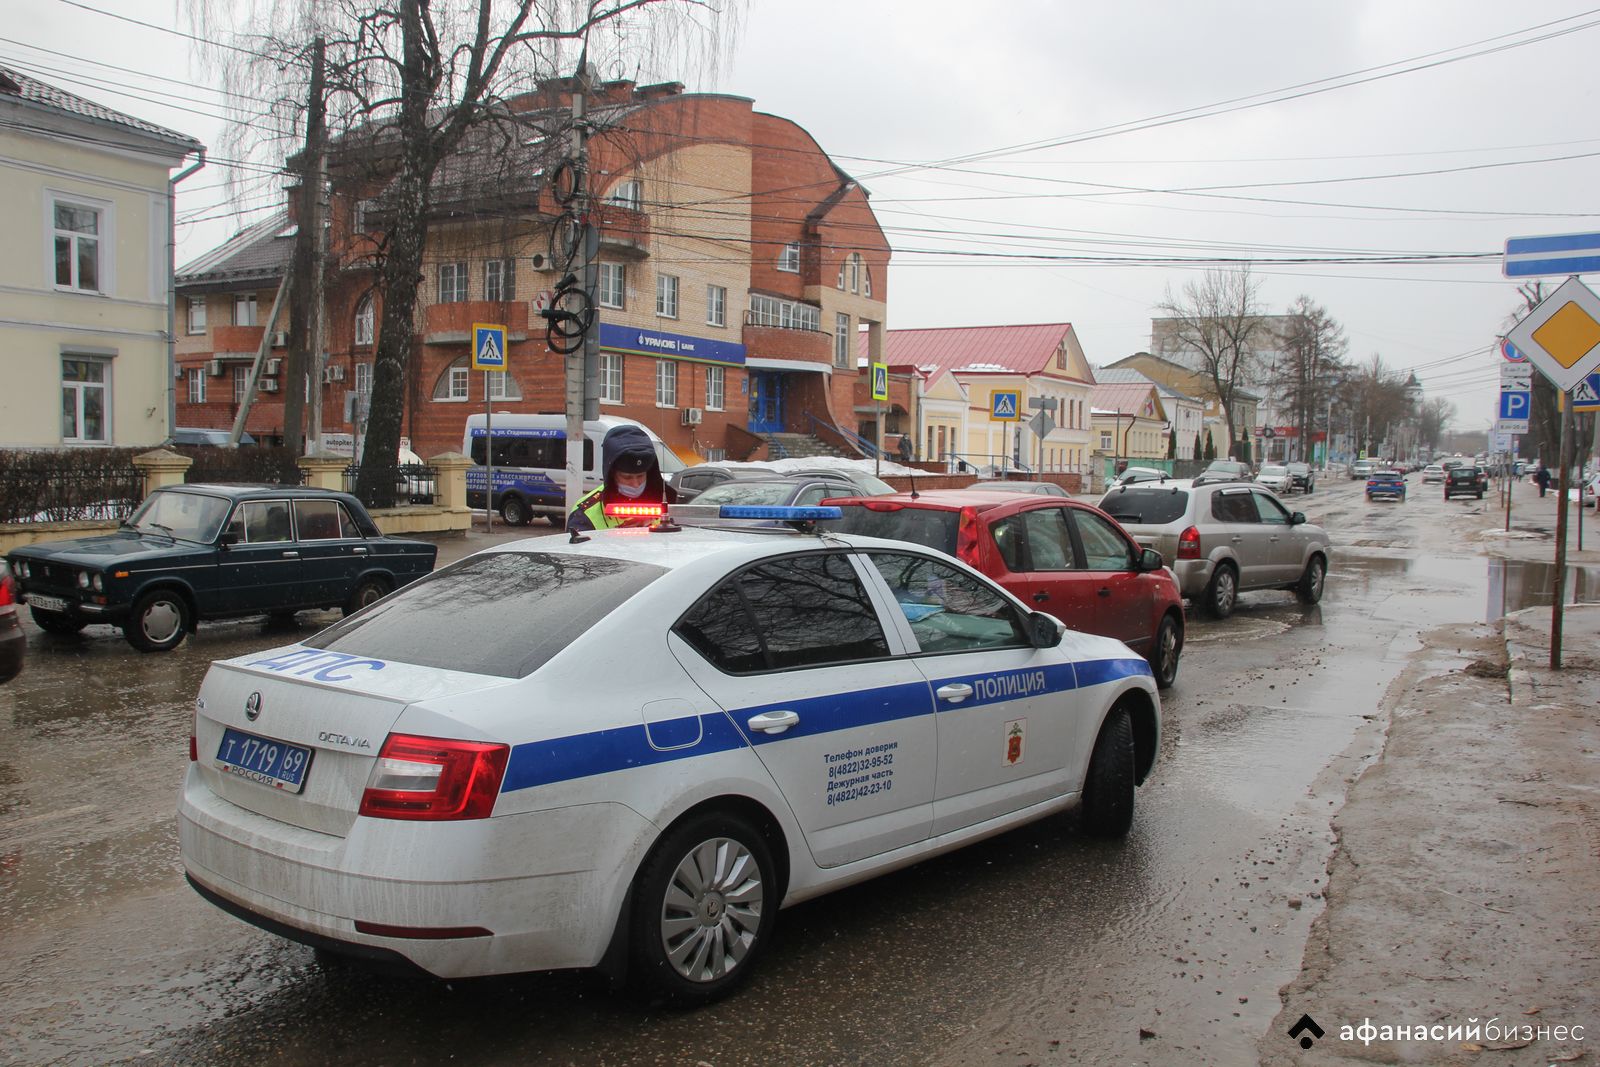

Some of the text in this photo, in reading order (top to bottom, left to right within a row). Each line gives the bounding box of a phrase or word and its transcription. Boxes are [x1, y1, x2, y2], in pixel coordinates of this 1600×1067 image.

[644, 336, 676, 350] УРАЛСИБ
[1507, 394, 1525, 417] P
[246, 650, 386, 682] ДПС
[974, 671, 1046, 700] ПОЛИЦИЯ
[318, 731, 371, 749] OCTAVIA
[240, 738, 278, 773] 1719
[283, 749, 304, 773] 69
[824, 742, 898, 763] Телефон доверия
[231, 766, 274, 785] РОССИЯ
[281, 770, 295, 782] RUS
[828, 753, 893, 779] 8(4822)32-95-52
[827, 769, 894, 793] Дежурная часть
[827, 779, 892, 807] 8(4822)42-23-10
